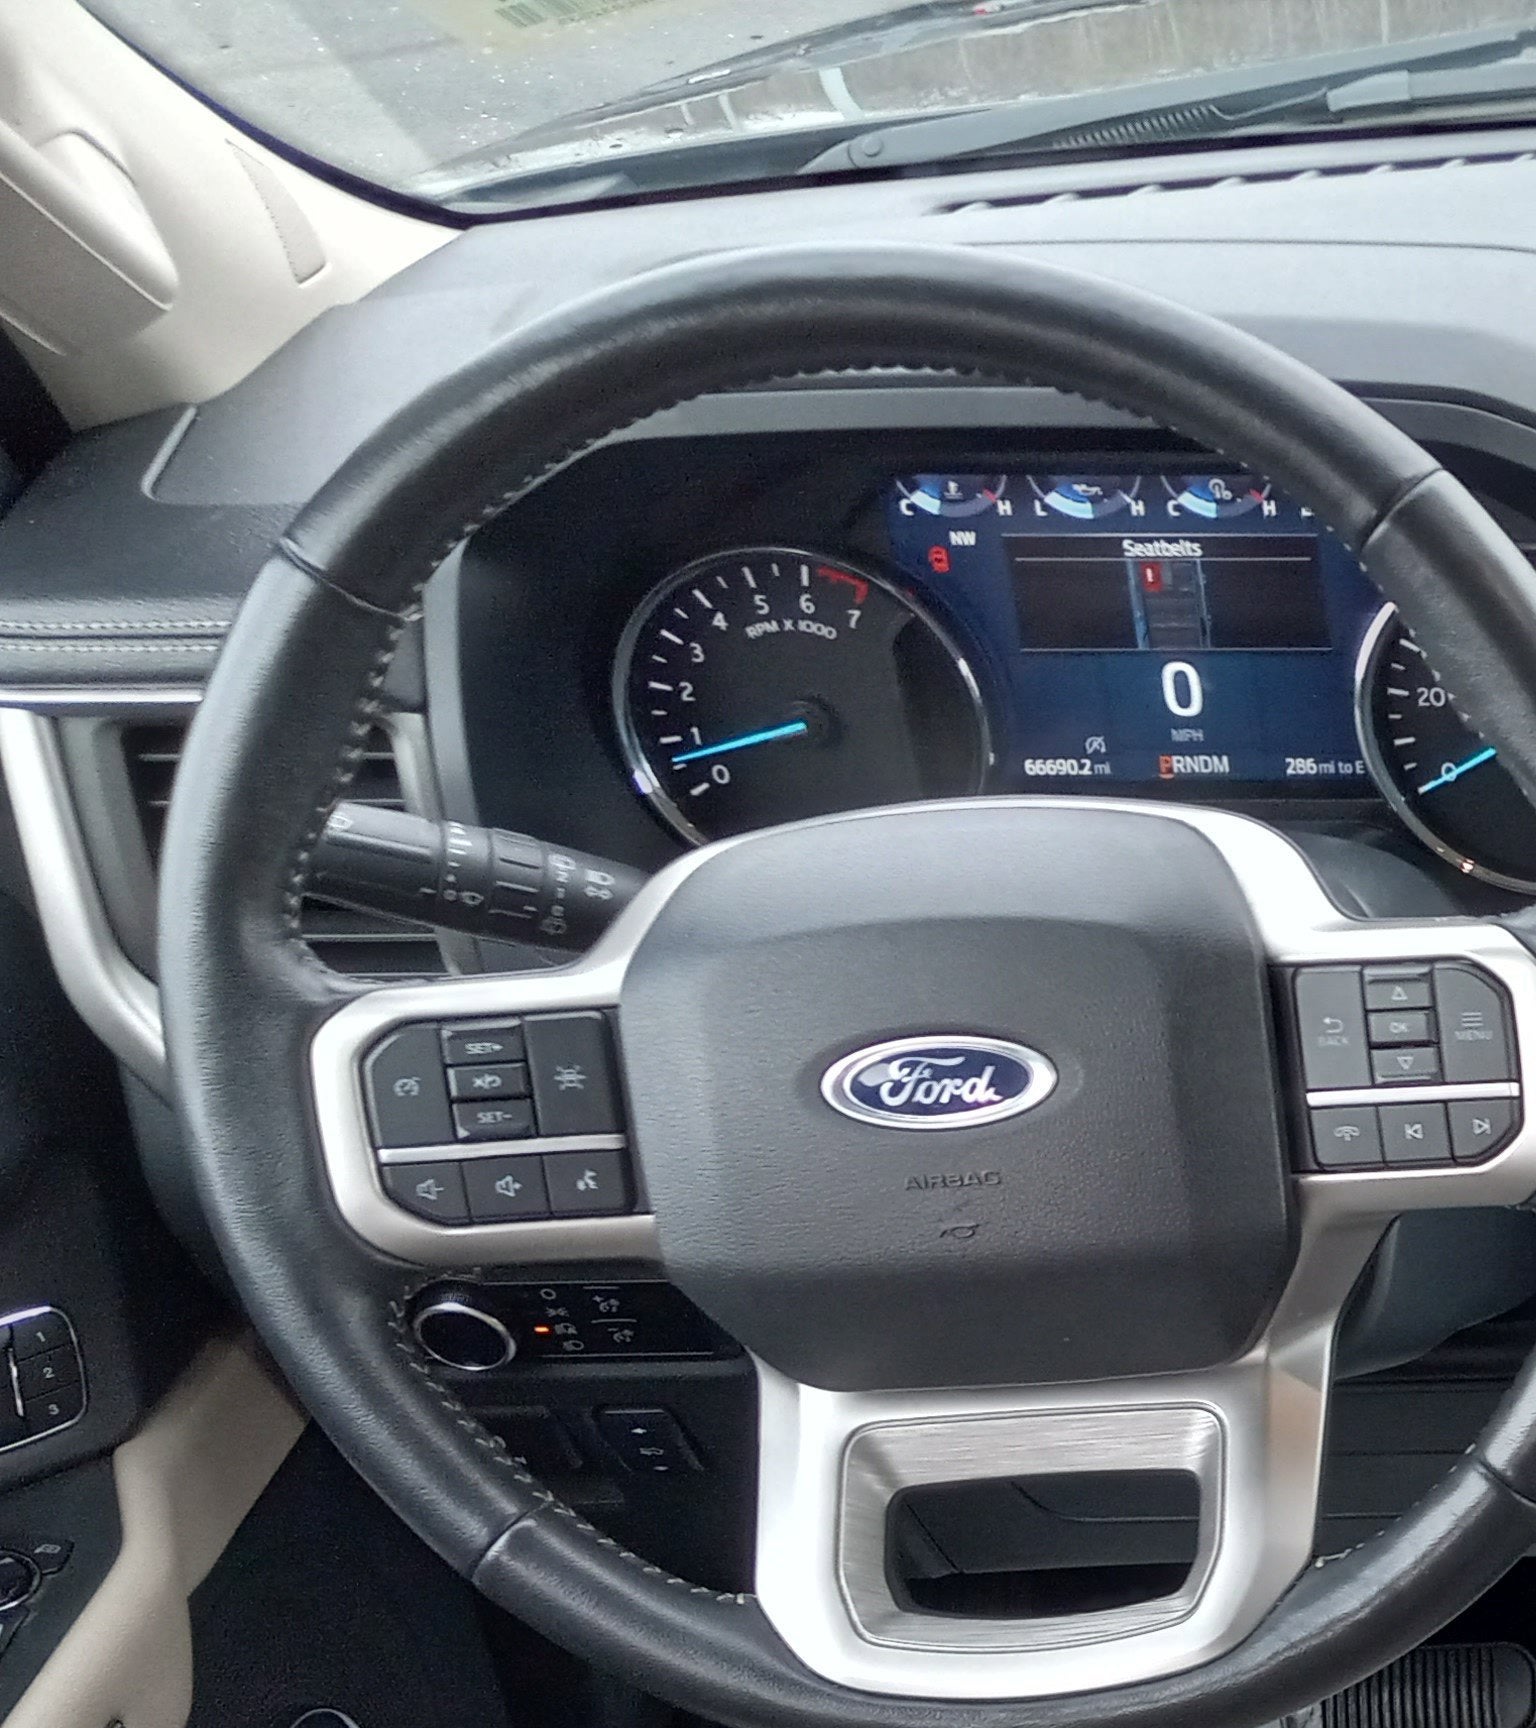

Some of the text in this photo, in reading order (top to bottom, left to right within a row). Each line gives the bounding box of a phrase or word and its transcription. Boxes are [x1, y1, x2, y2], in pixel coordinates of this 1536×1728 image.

[997, 501, 1013, 516] H
[1035, 501, 1047, 516] L
[1130, 501, 1145, 516] H
[1166, 501, 1181, 516] C
[1262, 501, 1277, 516] H
[949, 531, 976, 546] NW
[1122, 539, 1202, 557] Seatbelts
[754, 594, 770, 615] 5
[800, 593, 815, 614] 6
[712, 611, 729, 630] 4
[847, 609, 862, 630] 7
[745, 619, 781, 640] RPM
[797, 619, 837, 640] 1000
[689, 643, 704, 663] 3
[679, 682, 696, 701] 2
[1161, 661, 1204, 717] 0
[1416, 687, 1447, 707] 20
[690, 726, 701, 745] 1
[711, 764, 730, 784] 0
[1024, 758, 1093, 775] 66690.2
[1285, 757, 1318, 775] 286
[1339, 762, 1352, 774] to
[879, 1056, 1004, 1107] Ford
[905, 1169, 1002, 1191] AIRBAG
[43, 1367, 55, 1379] 2
[48, 1404, 60, 1415] 3
